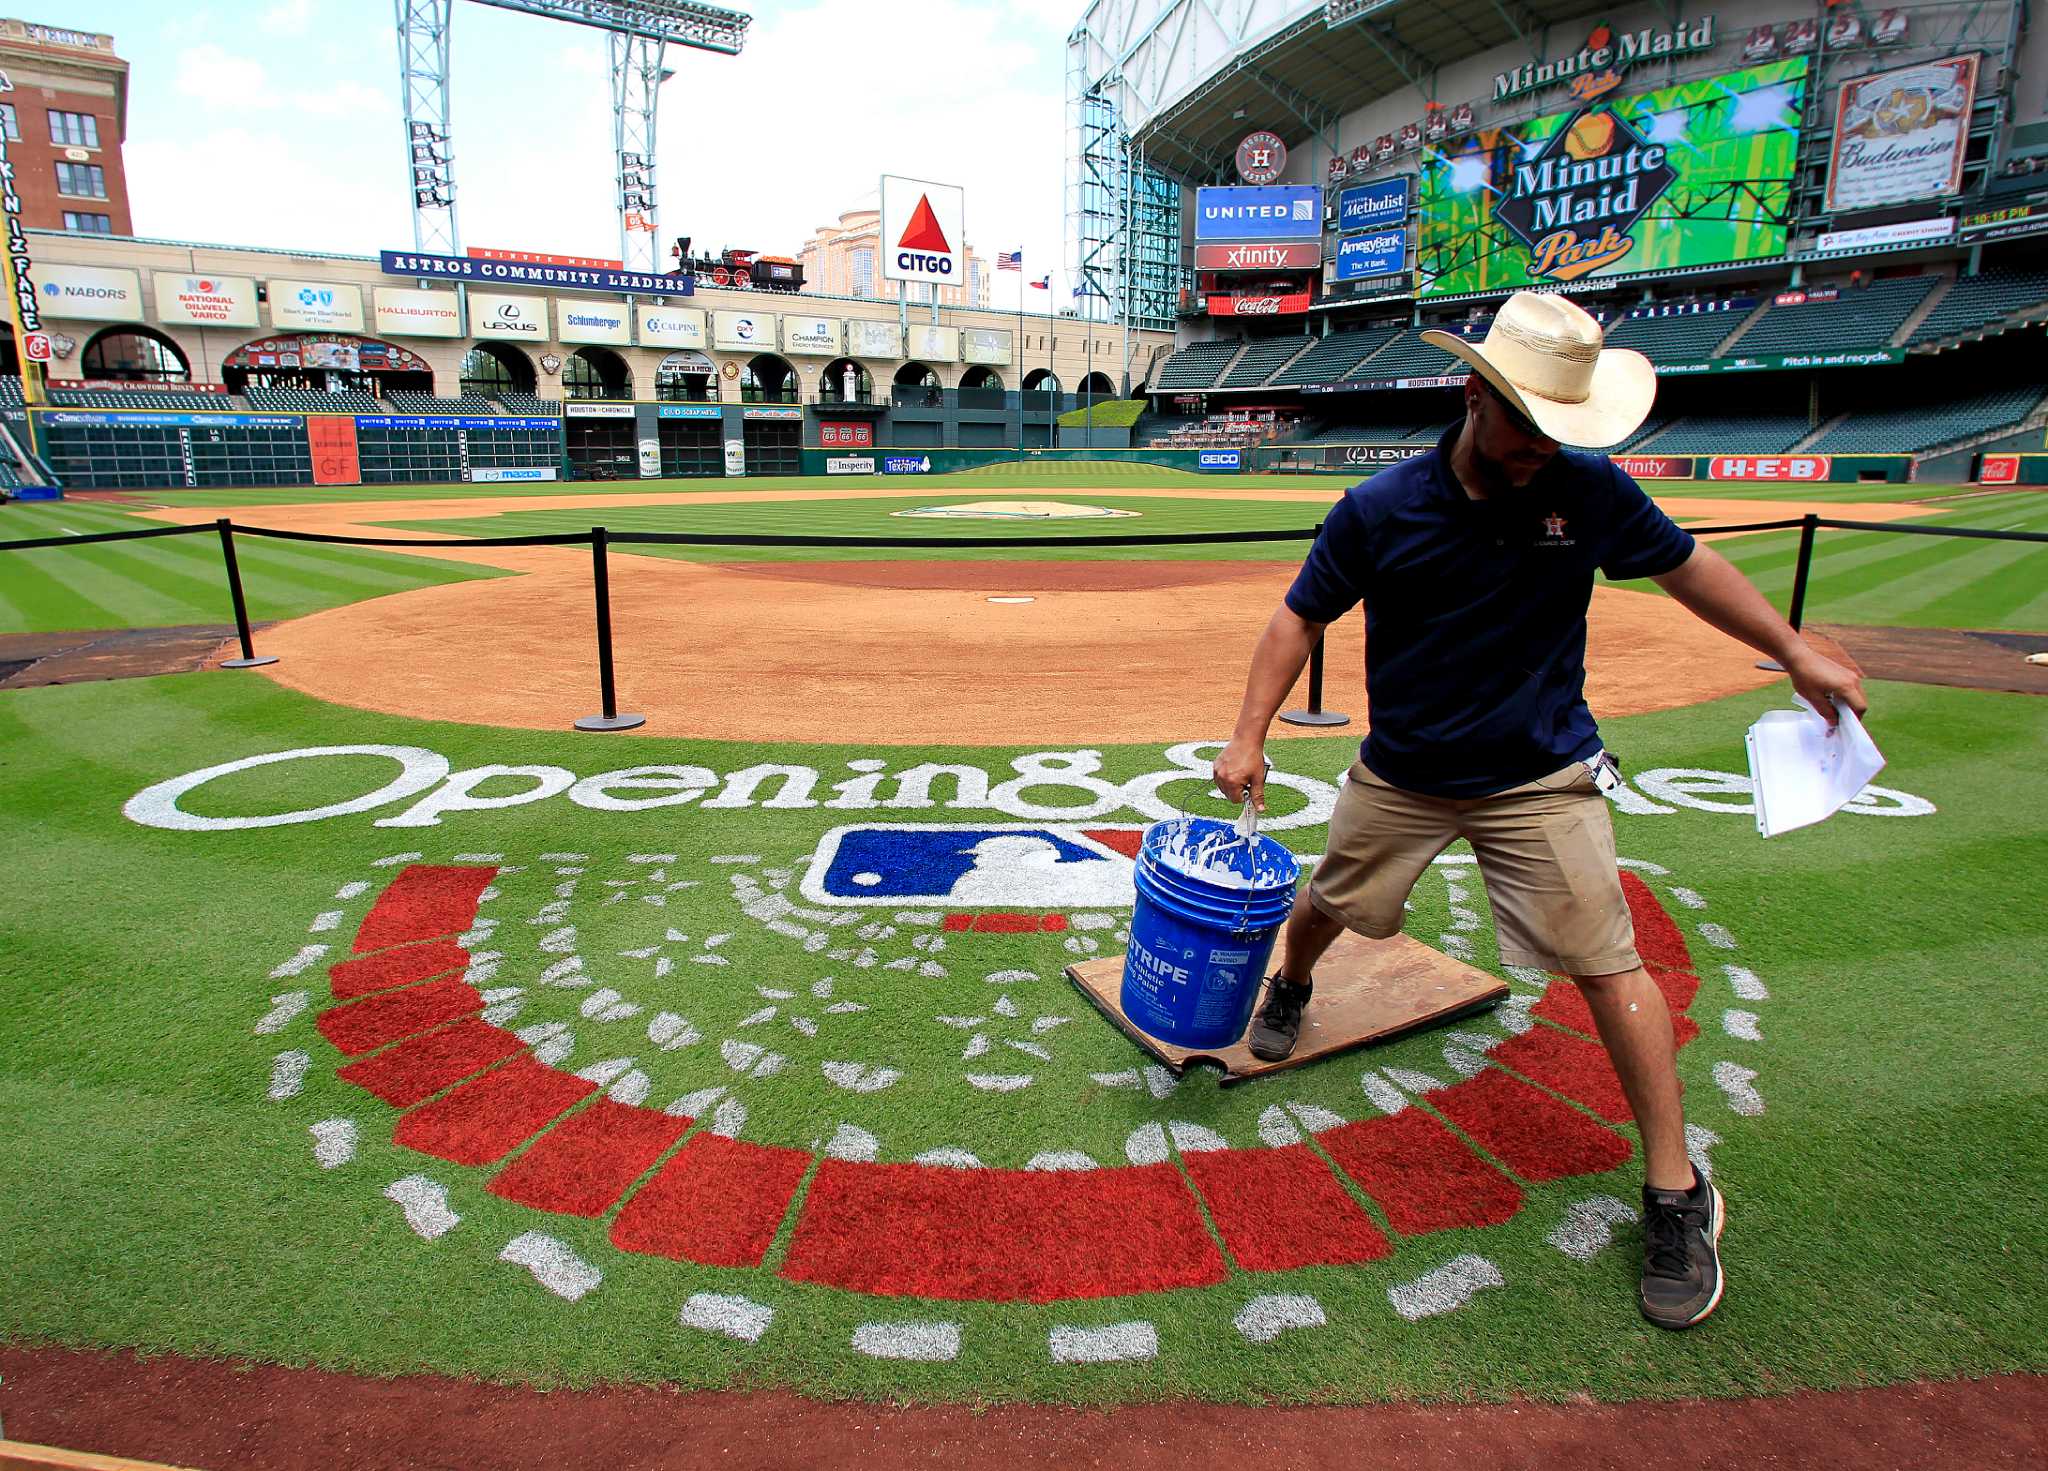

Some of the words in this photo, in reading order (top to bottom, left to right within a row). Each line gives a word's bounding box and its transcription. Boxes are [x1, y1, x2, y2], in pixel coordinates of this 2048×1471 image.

[1492, 46, 1612, 100] Minute
[1617, 16, 1716, 62] Maid
[1242, 134, 1281, 150] HOUSTON
[1252, 150, 1270, 167] H
[1352, 145, 1367, 161] 40
[1839, 137, 1955, 169] Budweiser
[1243, 169, 1277, 181] ASTROS
[1513, 144, 1665, 198] Minute
[420, 191, 434, 202] 98
[1531, 176, 1639, 231] Maid
[1205, 205, 1288, 220] UNITED
[1343, 194, 1404, 218] Methodist
[1227, 247, 1289, 267] xfinity
[1526, 224, 1630, 276] Park
[484, 250, 554, 262] MINUTE
[568, 258, 611, 268] MAID
[897, 252, 952, 275] CITGO
[393, 256, 472, 274] ASTROS
[481, 264, 601, 286] COMMUNITY
[608, 274, 685, 291] LEADERS
[13, 257, 41, 330] FARE
[64, 286, 127, 300] NABORS
[178, 294, 234, 305] NATIONAL
[185, 303, 232, 312] OILWELL
[377, 306, 457, 318] HALLIBURTON
[1234, 295, 1283, 315] Coca-Cola
[1646, 300, 1731, 317] ASTROS
[191, 312, 227, 320] VARCO
[567, 314, 621, 330] Schlumberger
[483, 322, 538, 332] LEXUS
[661, 322, 698, 332] CALPINE
[736, 325, 754, 333] OXY
[792, 333, 834, 344] CHAMPION
[1782, 356, 1810, 366] Pitch
[1812, 356, 1822, 366] in
[1824, 355, 1844, 364] and
[1846, 352, 1892, 366] recycle.
[1655, 363, 1710, 374] kGreen.com
[124, 382, 168, 391] CRAWFORD
[1408, 378, 1439, 388] HOUSTON
[6, 411, 26, 421] 315
[181, 430, 195, 485] NATIONAL
[460, 431, 470, 480] AMERICAN
[1200, 454, 1238, 464] GEICO
[838, 460, 874, 472] Insperity
[888, 460, 922, 472] TexanPl
[1722, 459, 1817, 477] H-E-B
[502, 470, 542, 479] mazda
[123, 744, 1119, 831] Opening
[1130, 932, 1189, 986] STRIPE
[1134, 960, 1166, 988] Athletic
[1136, 973, 1159, 994] Paint
